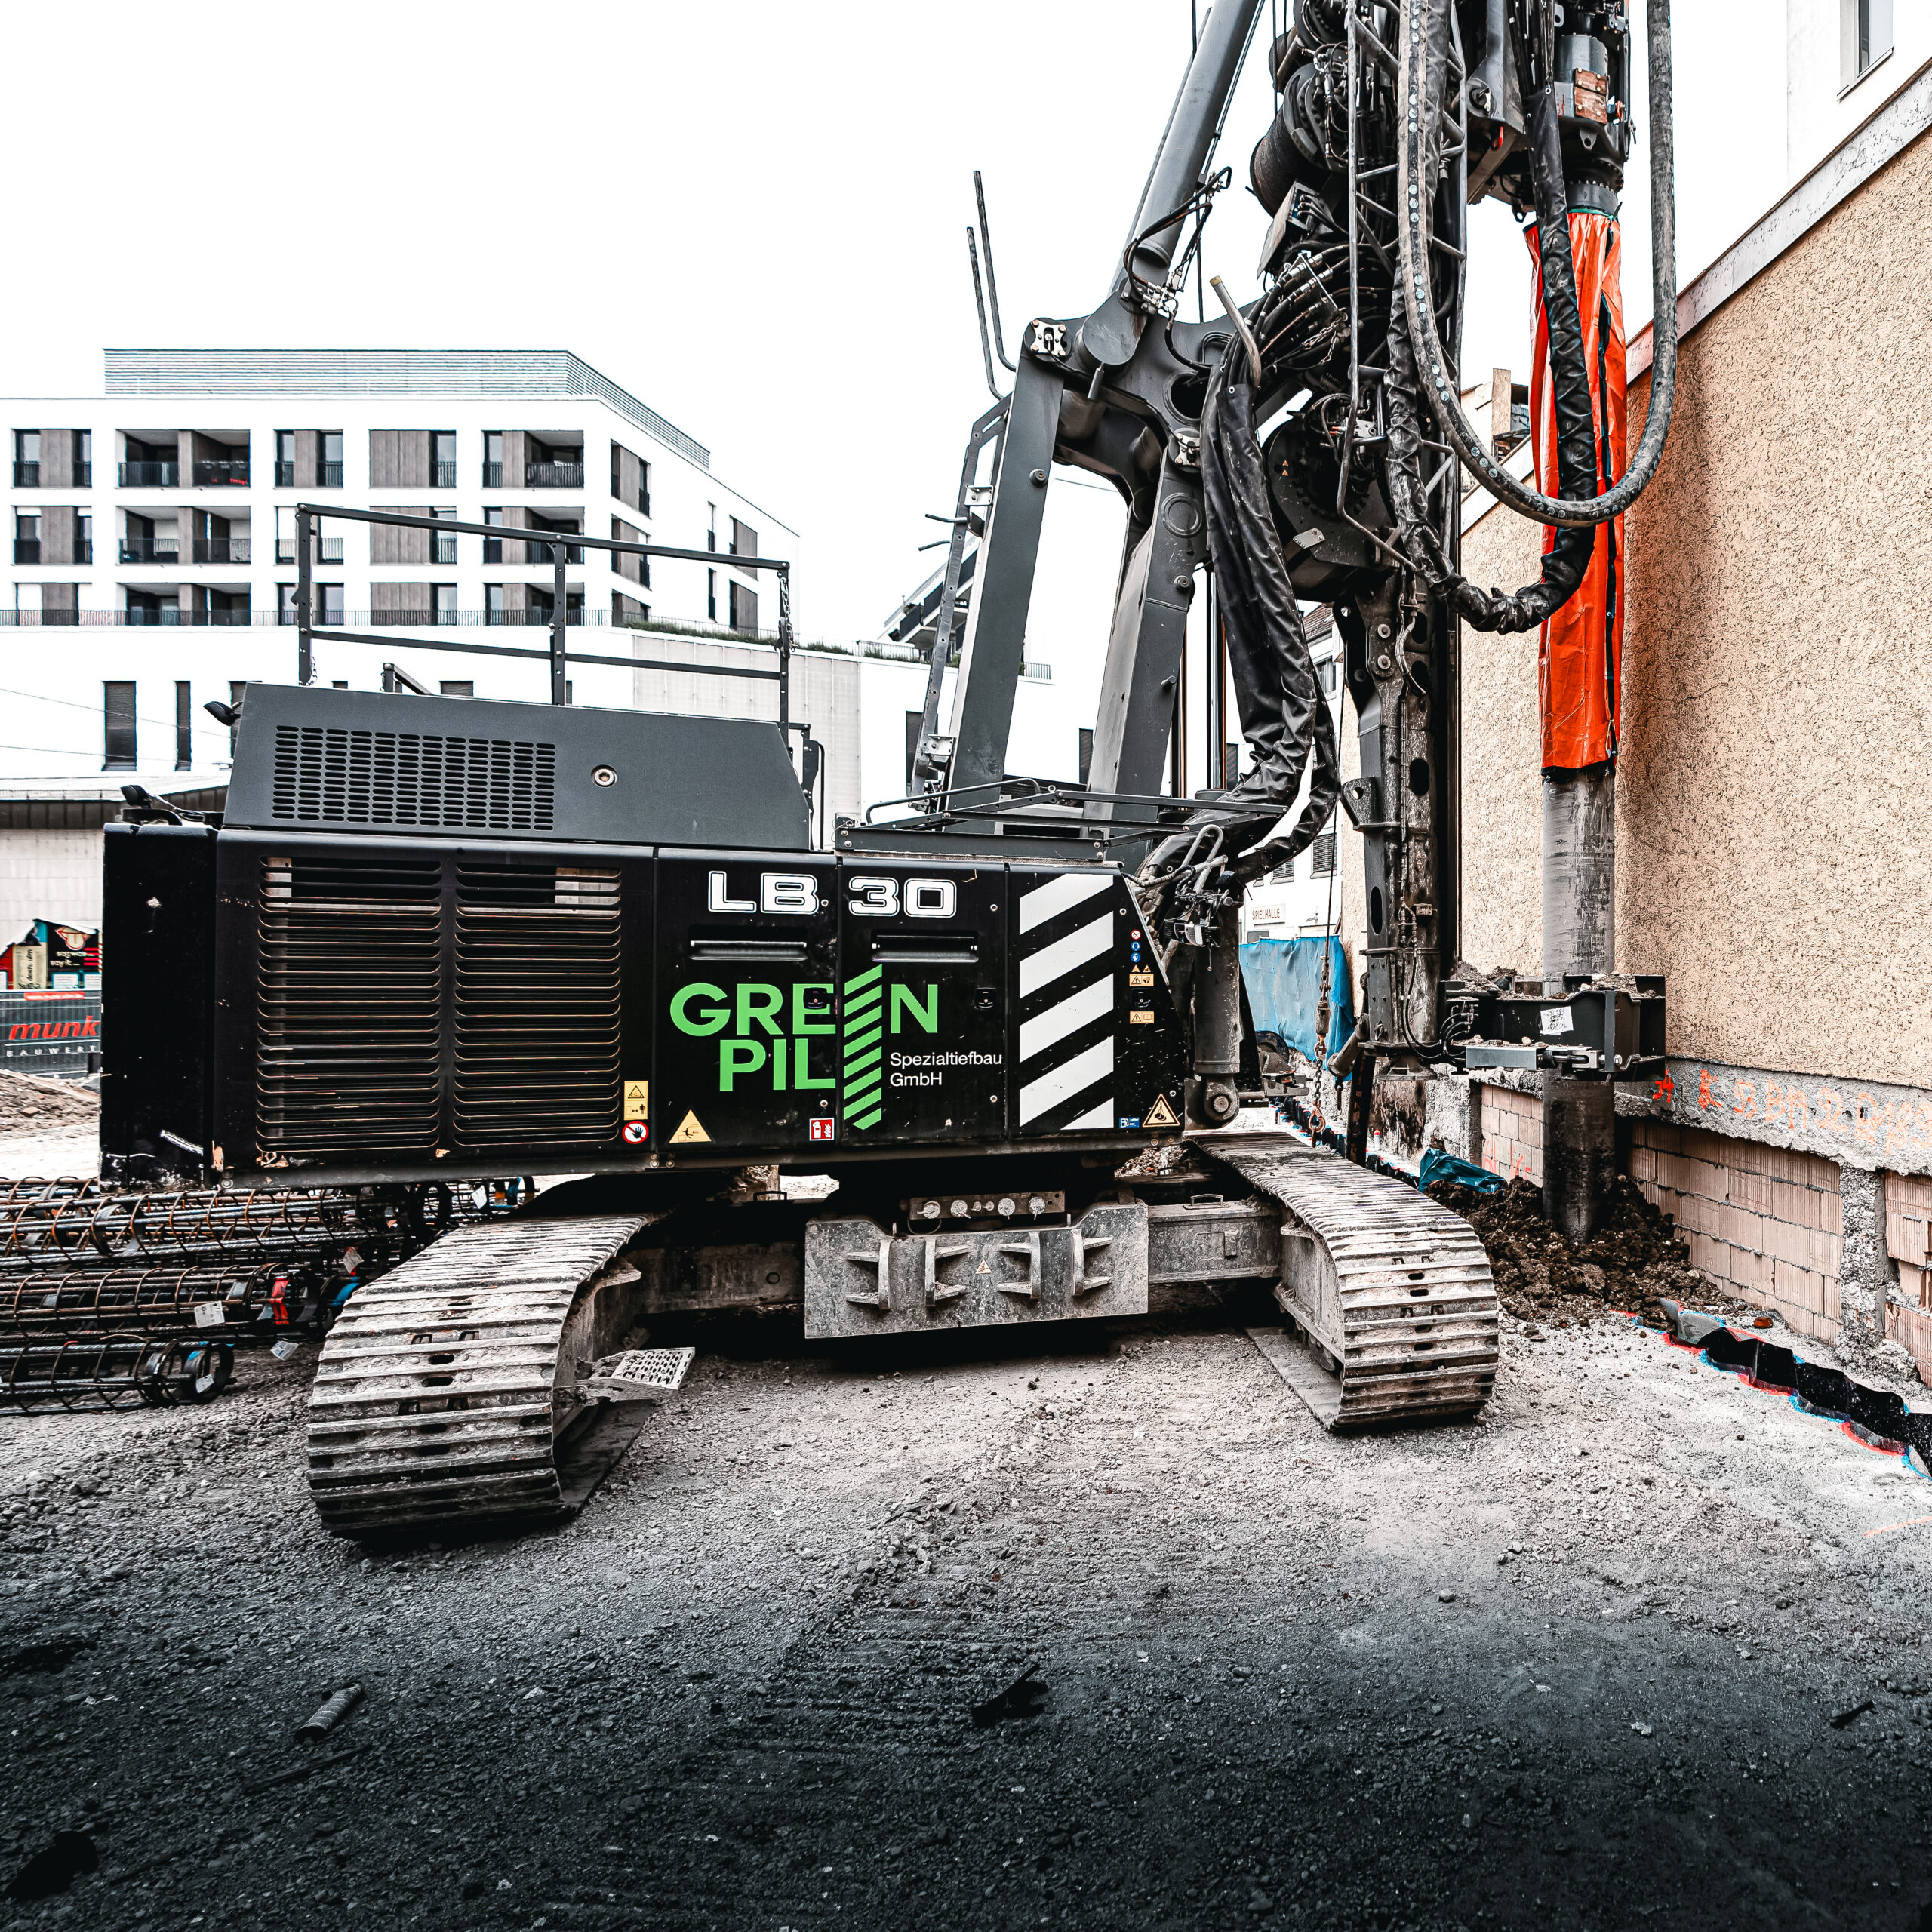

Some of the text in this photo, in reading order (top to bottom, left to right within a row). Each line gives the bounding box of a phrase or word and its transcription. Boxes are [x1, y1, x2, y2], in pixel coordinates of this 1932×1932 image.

[707, 870, 957, 918] LB 30
[1251, 908, 1281, 921] SPIELHALLE
[8, 1015, 100, 1041] munk
[890, 1051, 1002, 1069] Spezialtiefbau
[890, 1071, 943, 1087] GmbH
